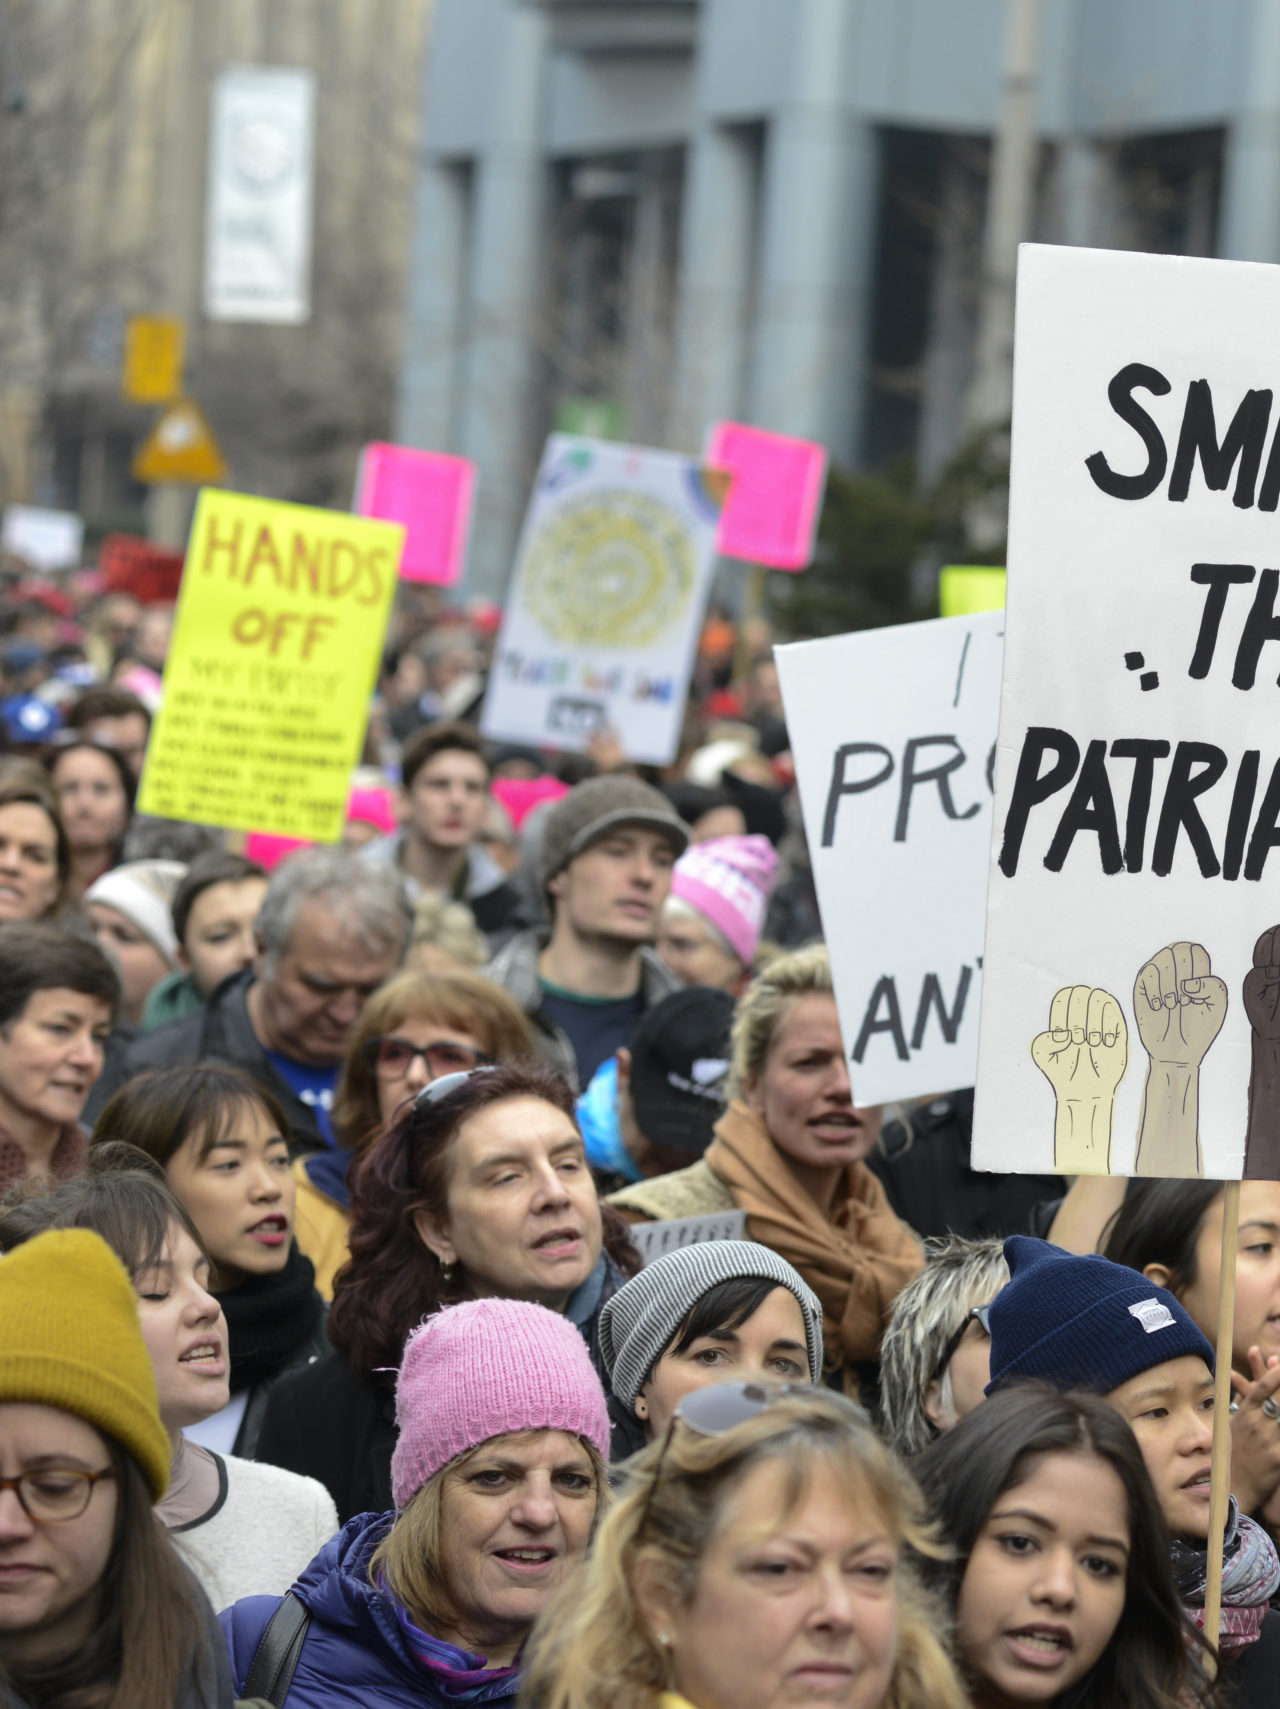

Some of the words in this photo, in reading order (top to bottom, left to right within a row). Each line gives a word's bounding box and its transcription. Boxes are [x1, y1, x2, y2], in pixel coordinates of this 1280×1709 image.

[202, 514, 390, 606] HANDS
[231, 607, 338, 663] OFF
[821, 735, 997, 848] PR
[852, 956, 983, 1063] AN
